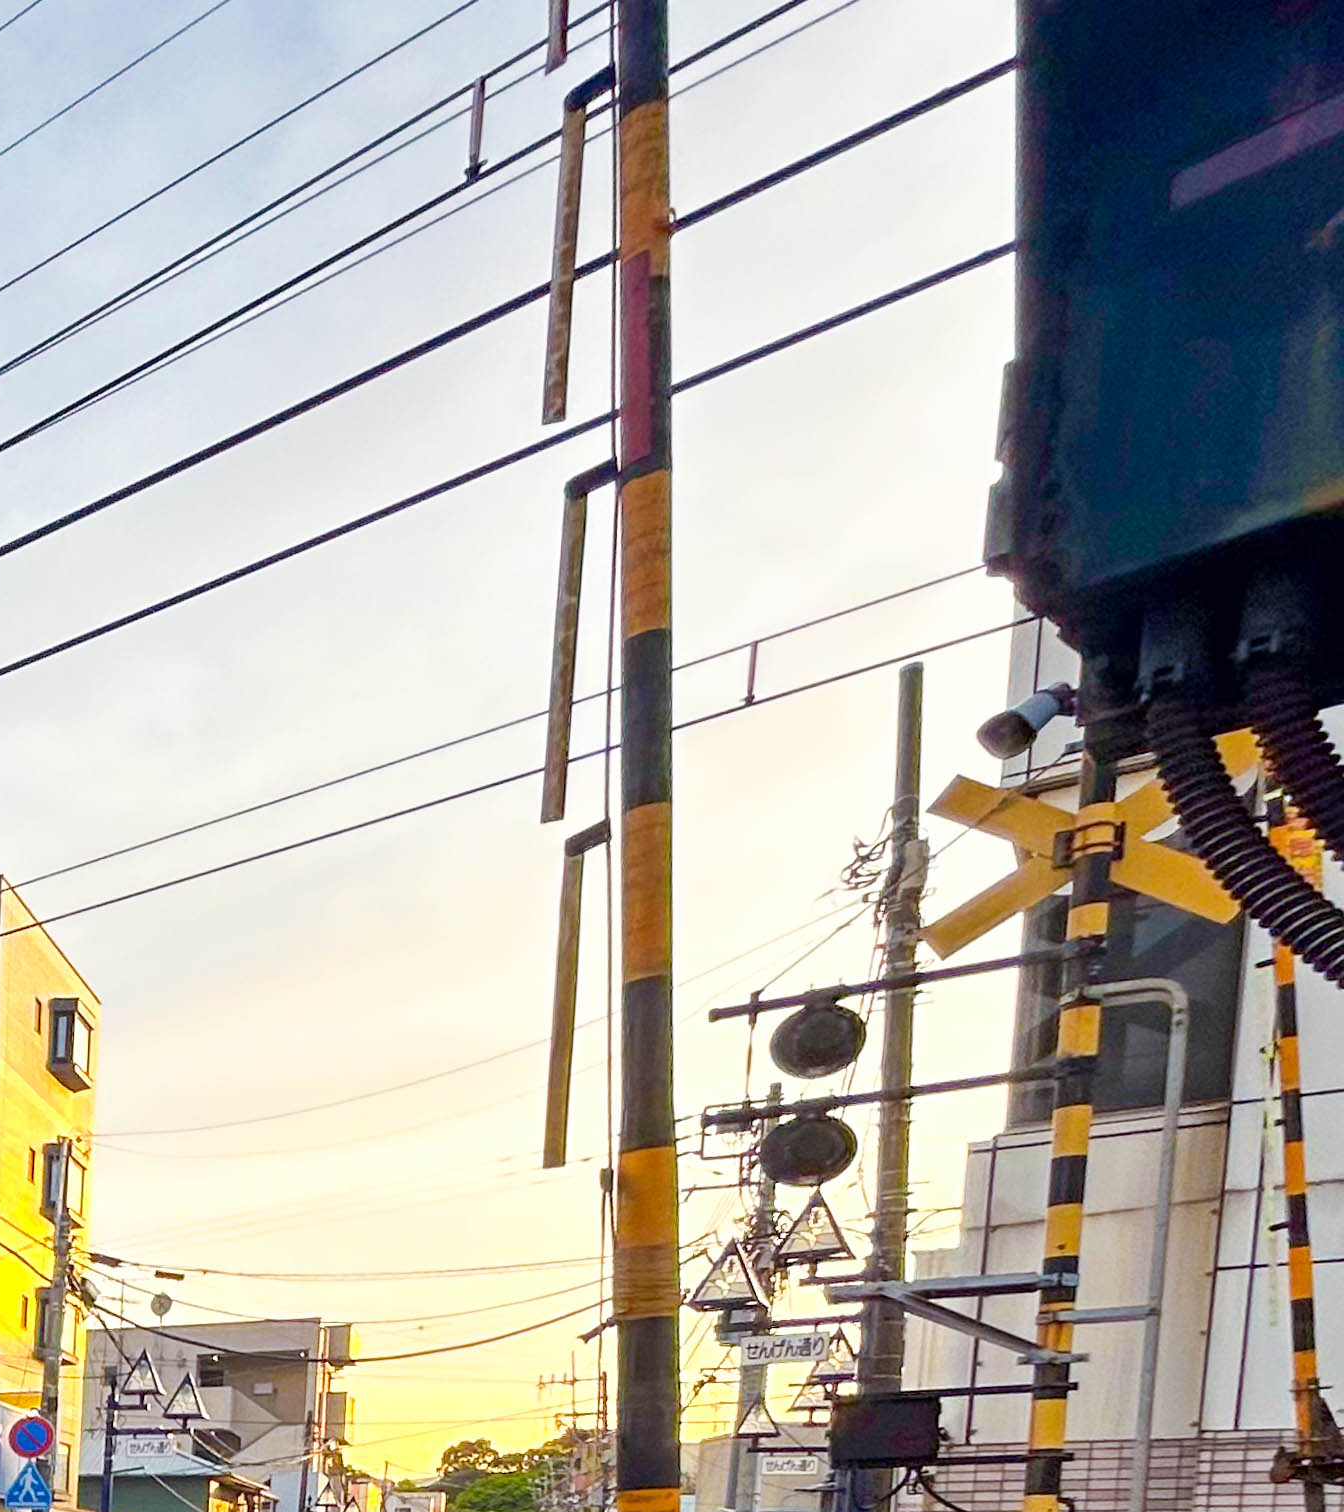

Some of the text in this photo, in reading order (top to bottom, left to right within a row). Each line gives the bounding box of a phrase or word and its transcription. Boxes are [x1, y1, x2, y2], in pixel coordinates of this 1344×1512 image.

[746, 1336, 825, 1360] せんげん通り
